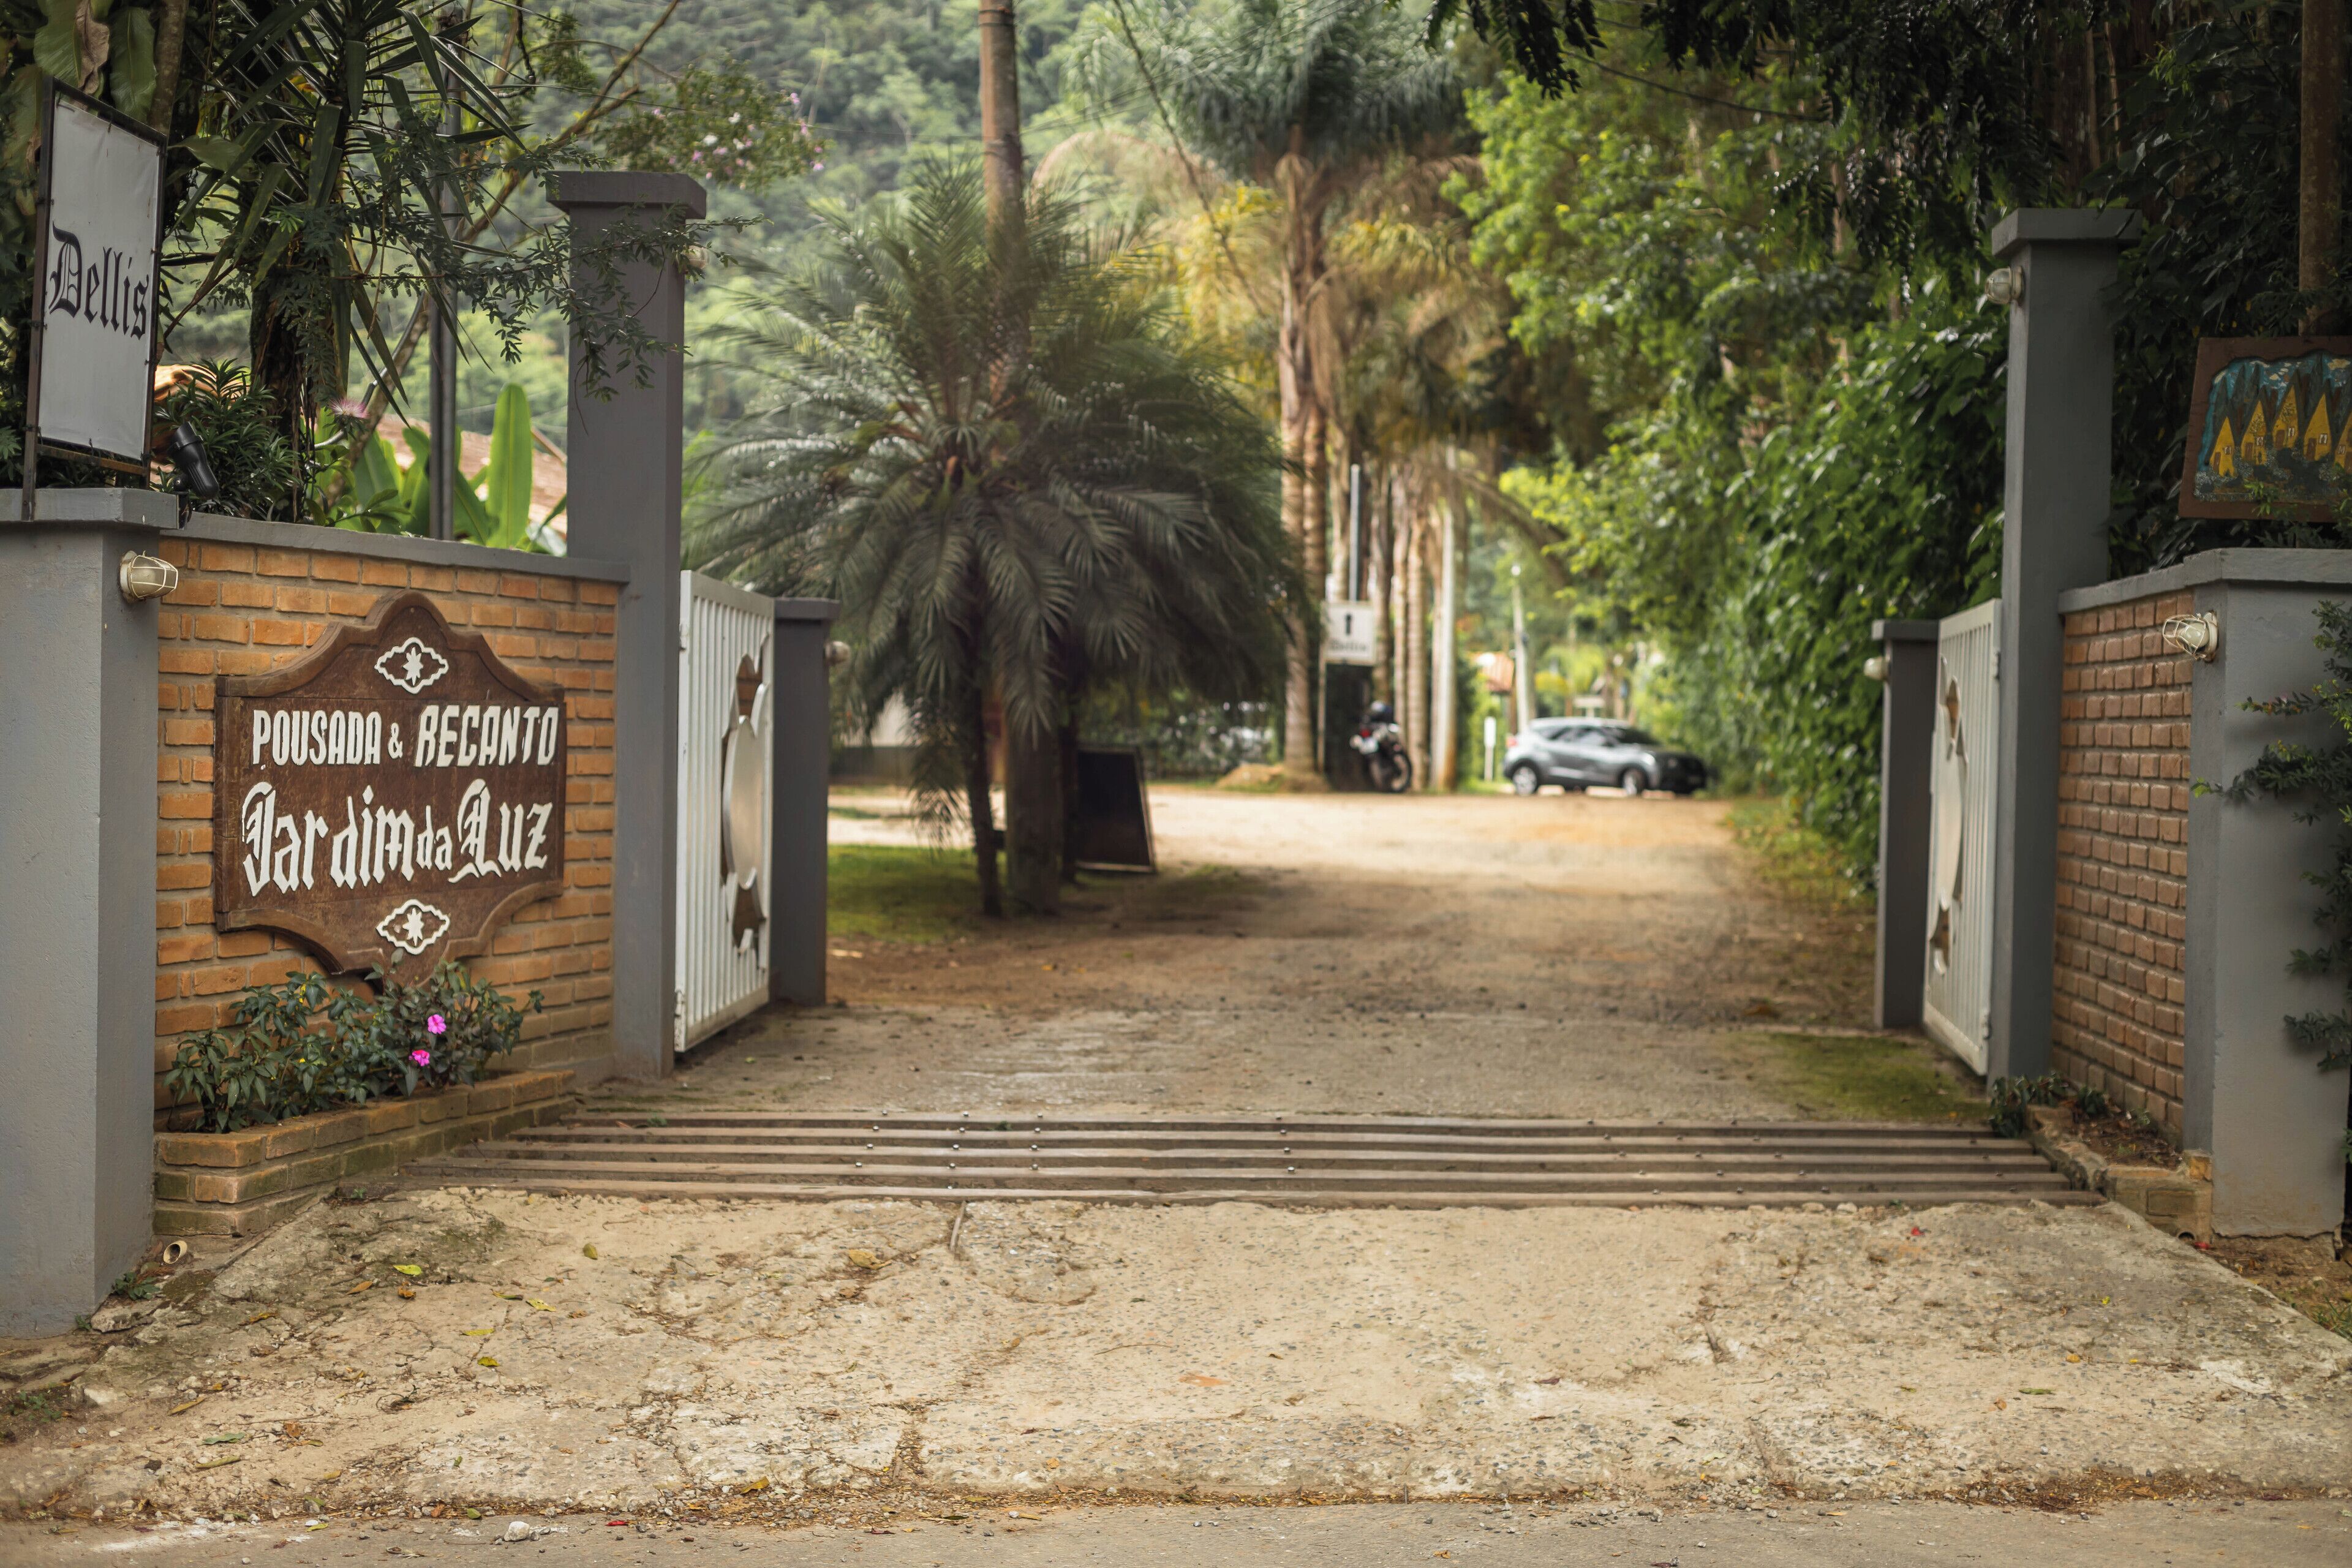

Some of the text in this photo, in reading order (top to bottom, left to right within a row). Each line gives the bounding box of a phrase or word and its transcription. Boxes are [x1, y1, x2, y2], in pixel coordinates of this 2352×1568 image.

[49, 221, 149, 341] Dellis
[252, 705, 559, 767] POUSADA & RECANTO
[417, 805, 453, 870] da
[448, 778, 552, 883] Luz
